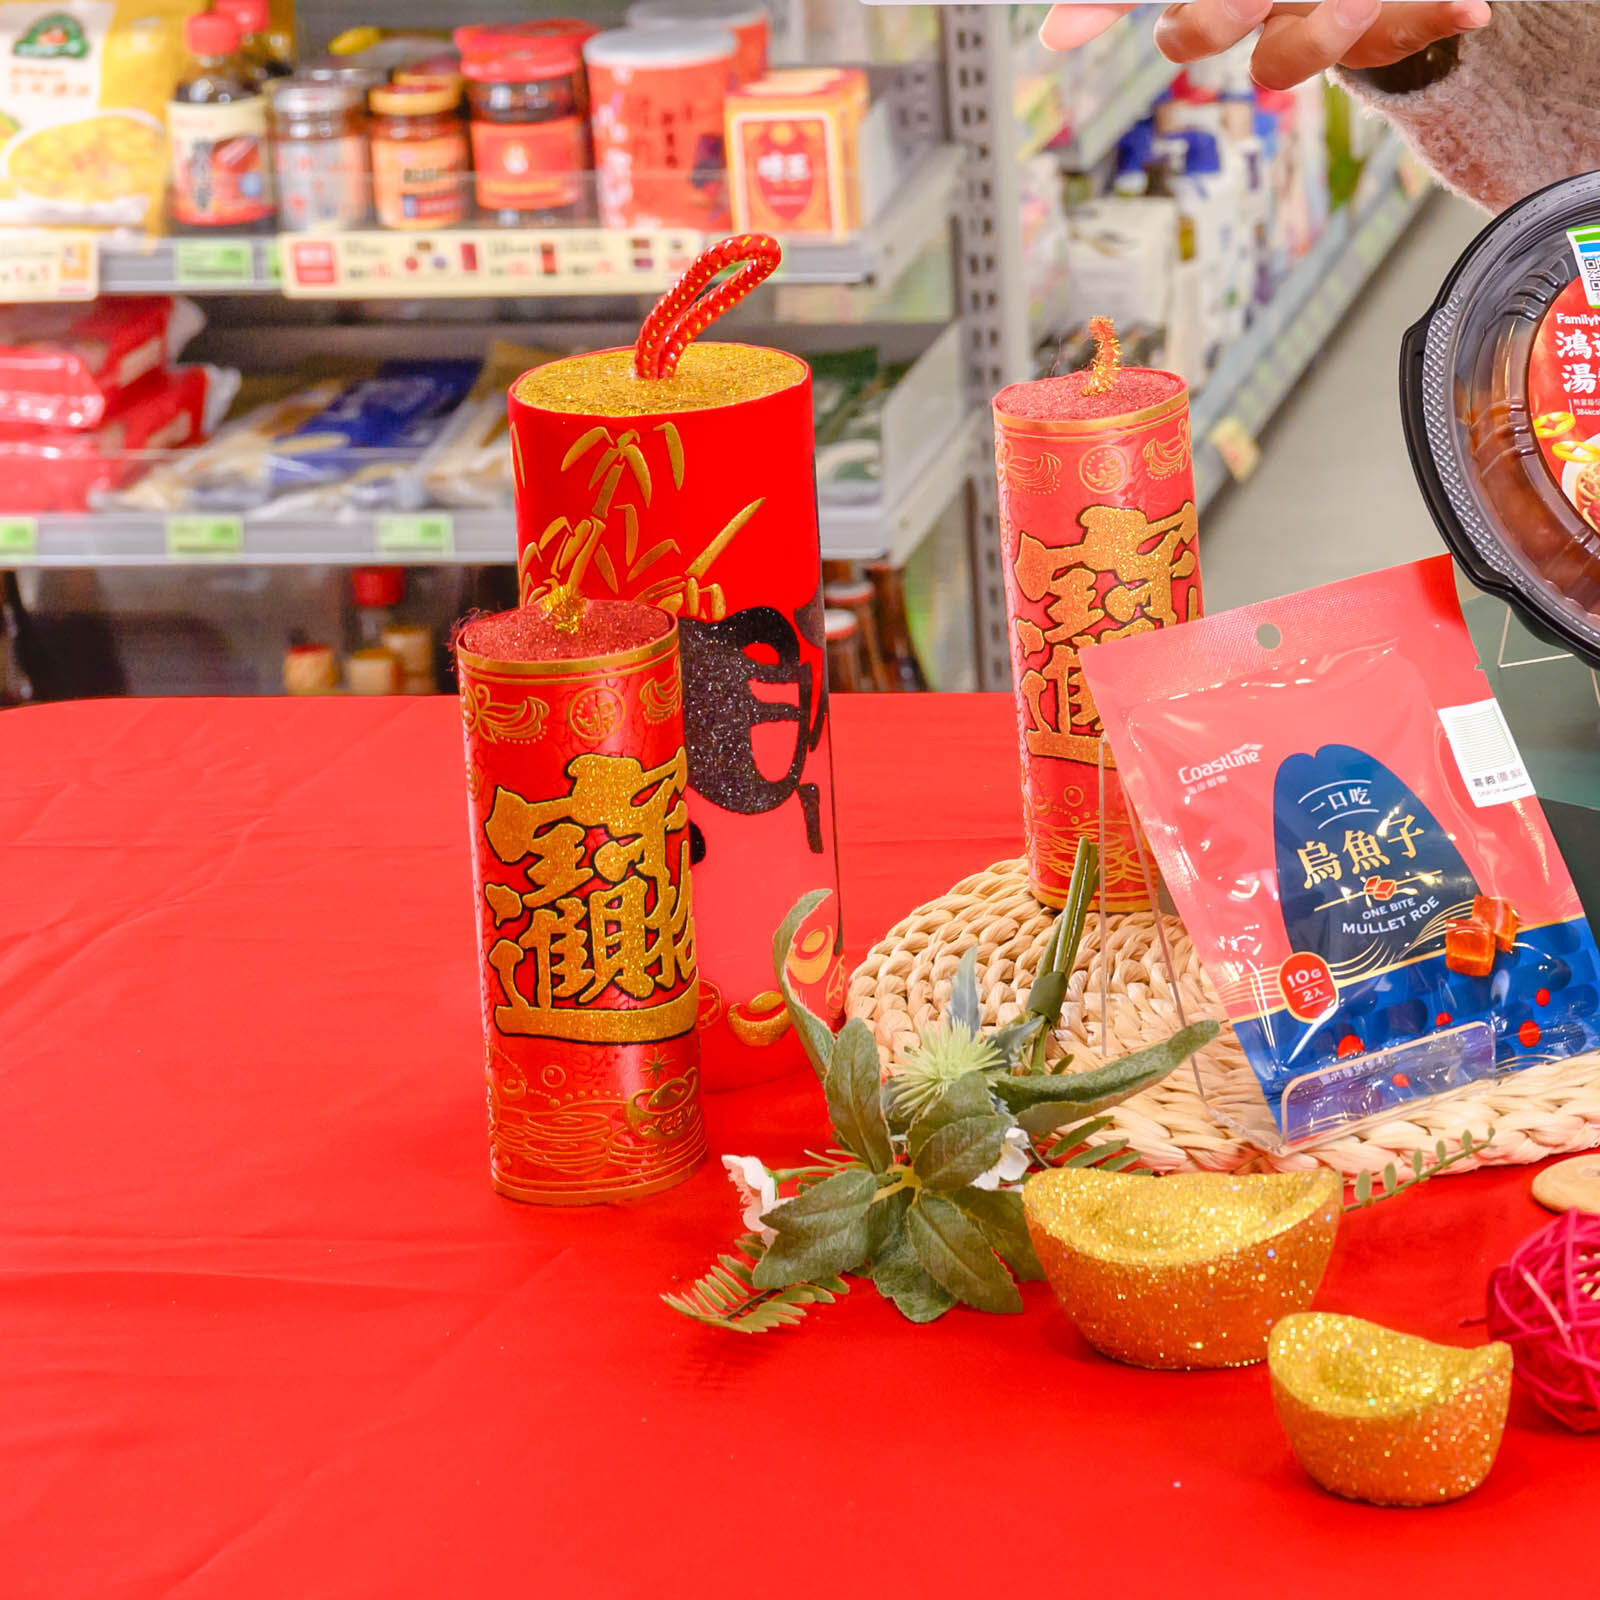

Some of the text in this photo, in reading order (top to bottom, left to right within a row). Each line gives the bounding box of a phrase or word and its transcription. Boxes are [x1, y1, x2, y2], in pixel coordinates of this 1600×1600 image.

[1178, 745, 1262, 786] Coastline
[1310, 786, 1372, 813] 一口吃
[1297, 814, 1425, 890] 烏魚子
[1342, 896, 1441, 936] MULLET ROE
[1362, 897, 1416, 921] ONE BITE
[1286, 968, 1323, 989] 10G
